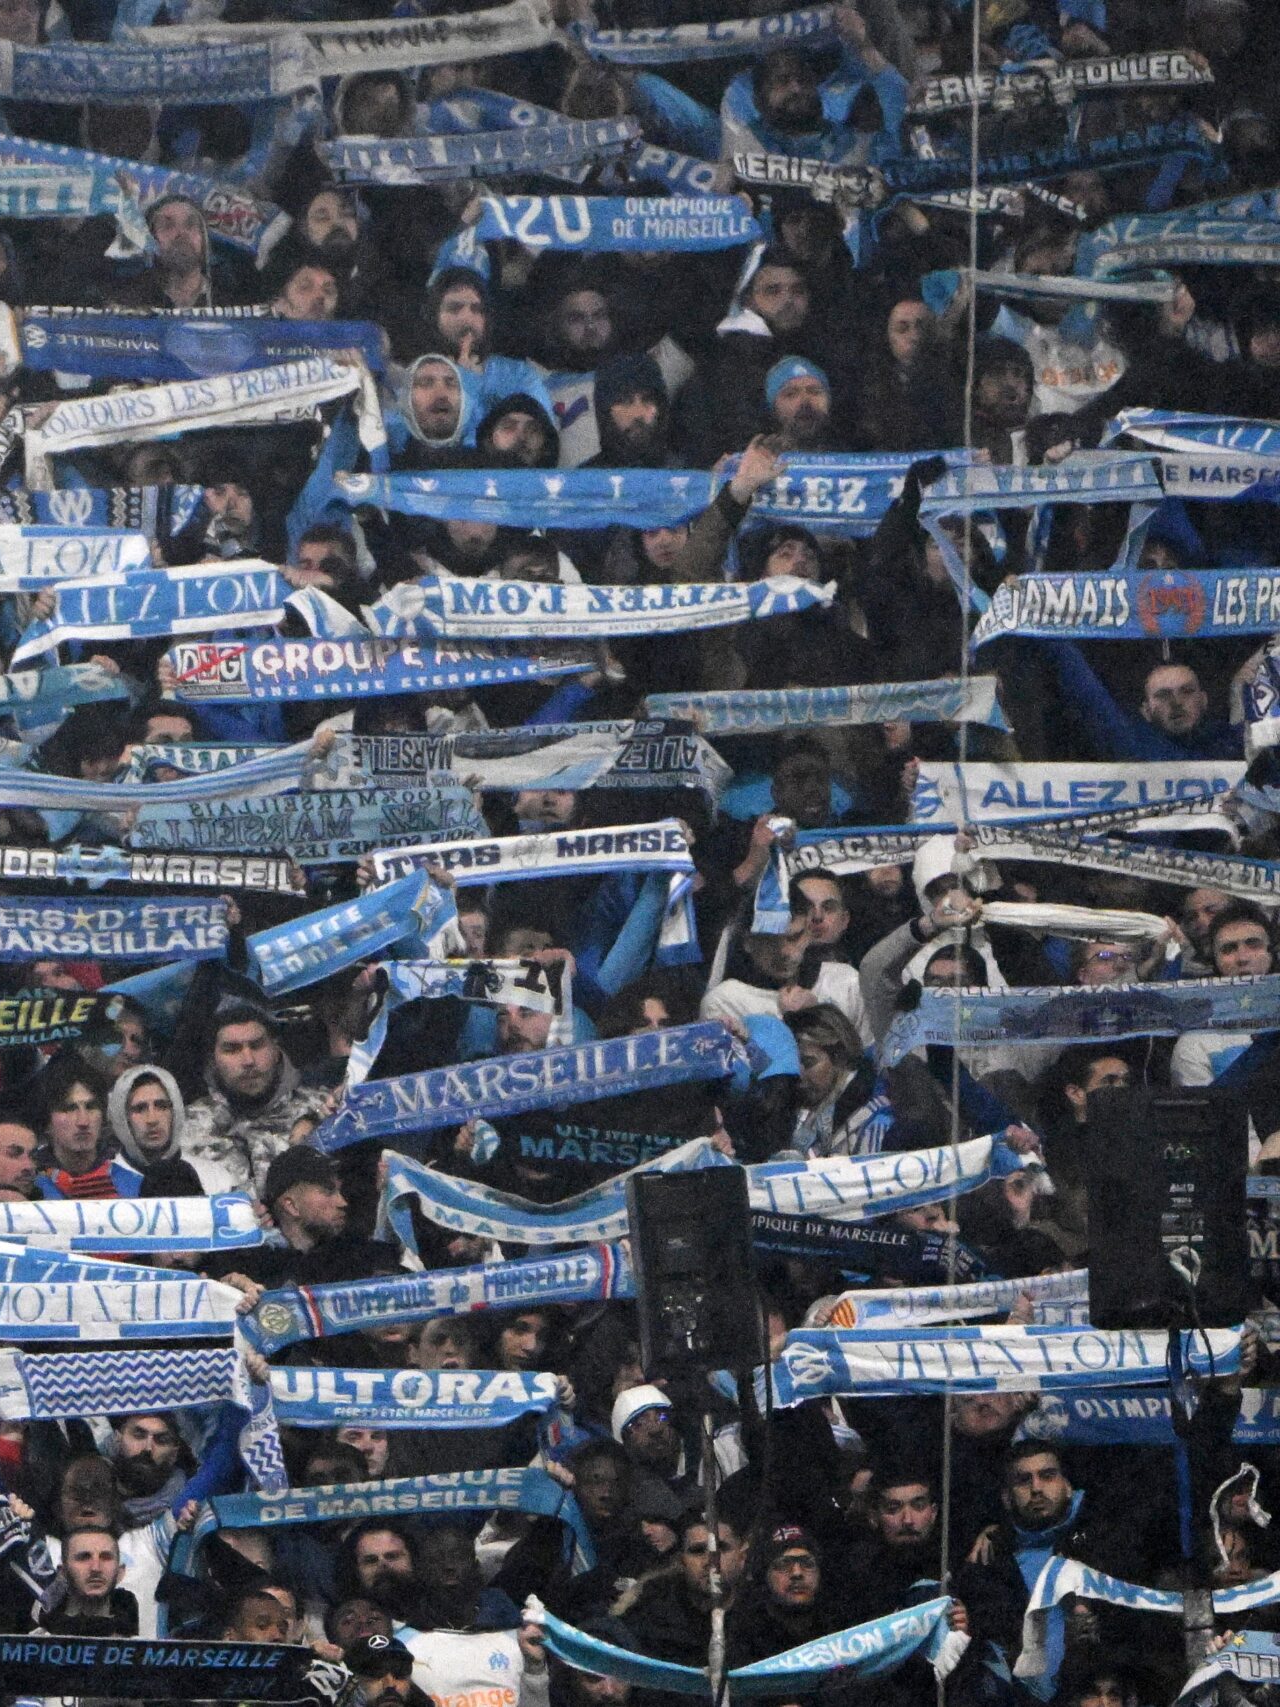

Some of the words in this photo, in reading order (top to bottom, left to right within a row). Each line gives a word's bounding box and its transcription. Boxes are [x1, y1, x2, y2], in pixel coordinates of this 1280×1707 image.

[642, 215, 753, 238] MARSEILLE
[167, 381, 218, 419] LES
[176, 570, 277, 618] L'OM
[1212, 577, 1249, 628] LES
[980, 779, 1129, 810] ALLEZ
[130, 852, 292, 893] MARSEIL
[389, 1029, 687, 1117] MARSEILLE
[520, 1139, 657, 1167] MARSE
[805, 1222, 826, 1237] DE
[830, 1224, 911, 1249] MARSEILLE
[1074, 1396, 1173, 1420] OLYMPI
[260, 1503, 307, 1522] DE
[317, 1488, 522, 1516] MARSEILLE
[103, 1645, 135, 1667] DE
[141, 1646, 286, 1671] MARSEILLE
